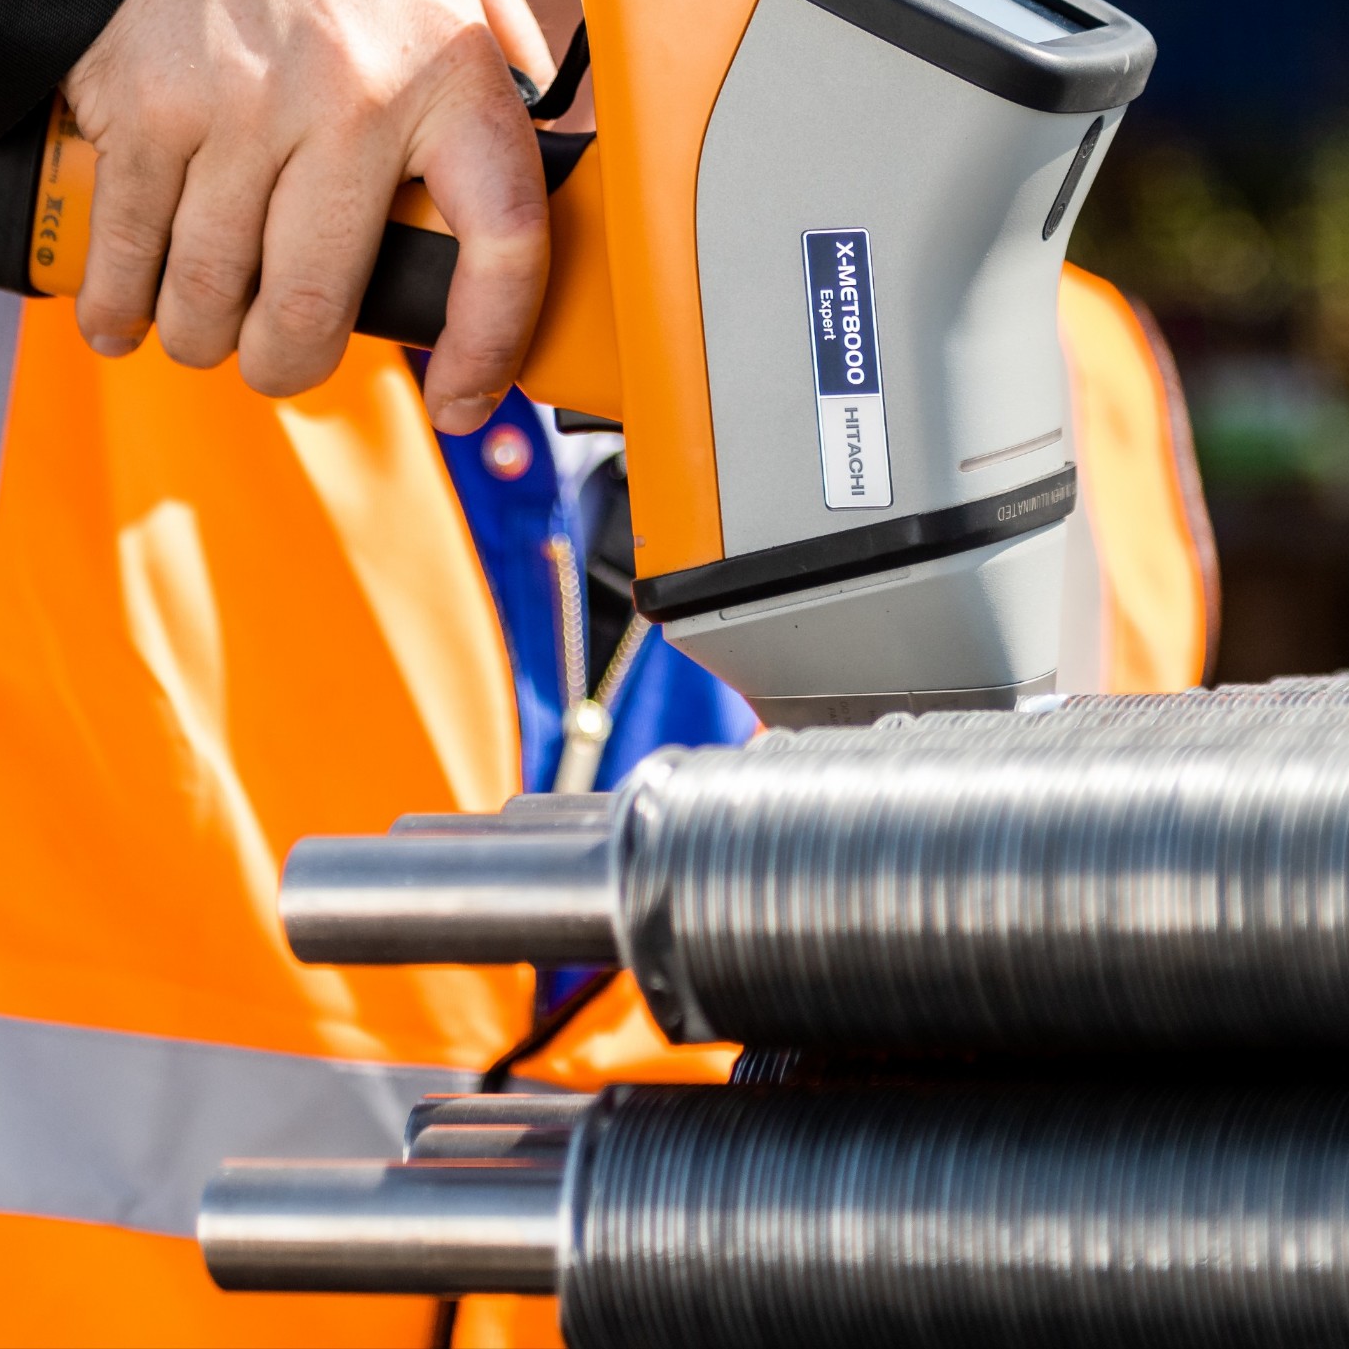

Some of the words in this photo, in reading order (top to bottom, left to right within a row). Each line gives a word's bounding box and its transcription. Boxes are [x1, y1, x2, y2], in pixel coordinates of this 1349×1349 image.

[819, 289, 836, 340] Expert
[835, 241, 865, 384] X-MET8000
[844, 406, 866, 497] HITACHI
[997, 492, 1050, 522] ILLUMINATED
